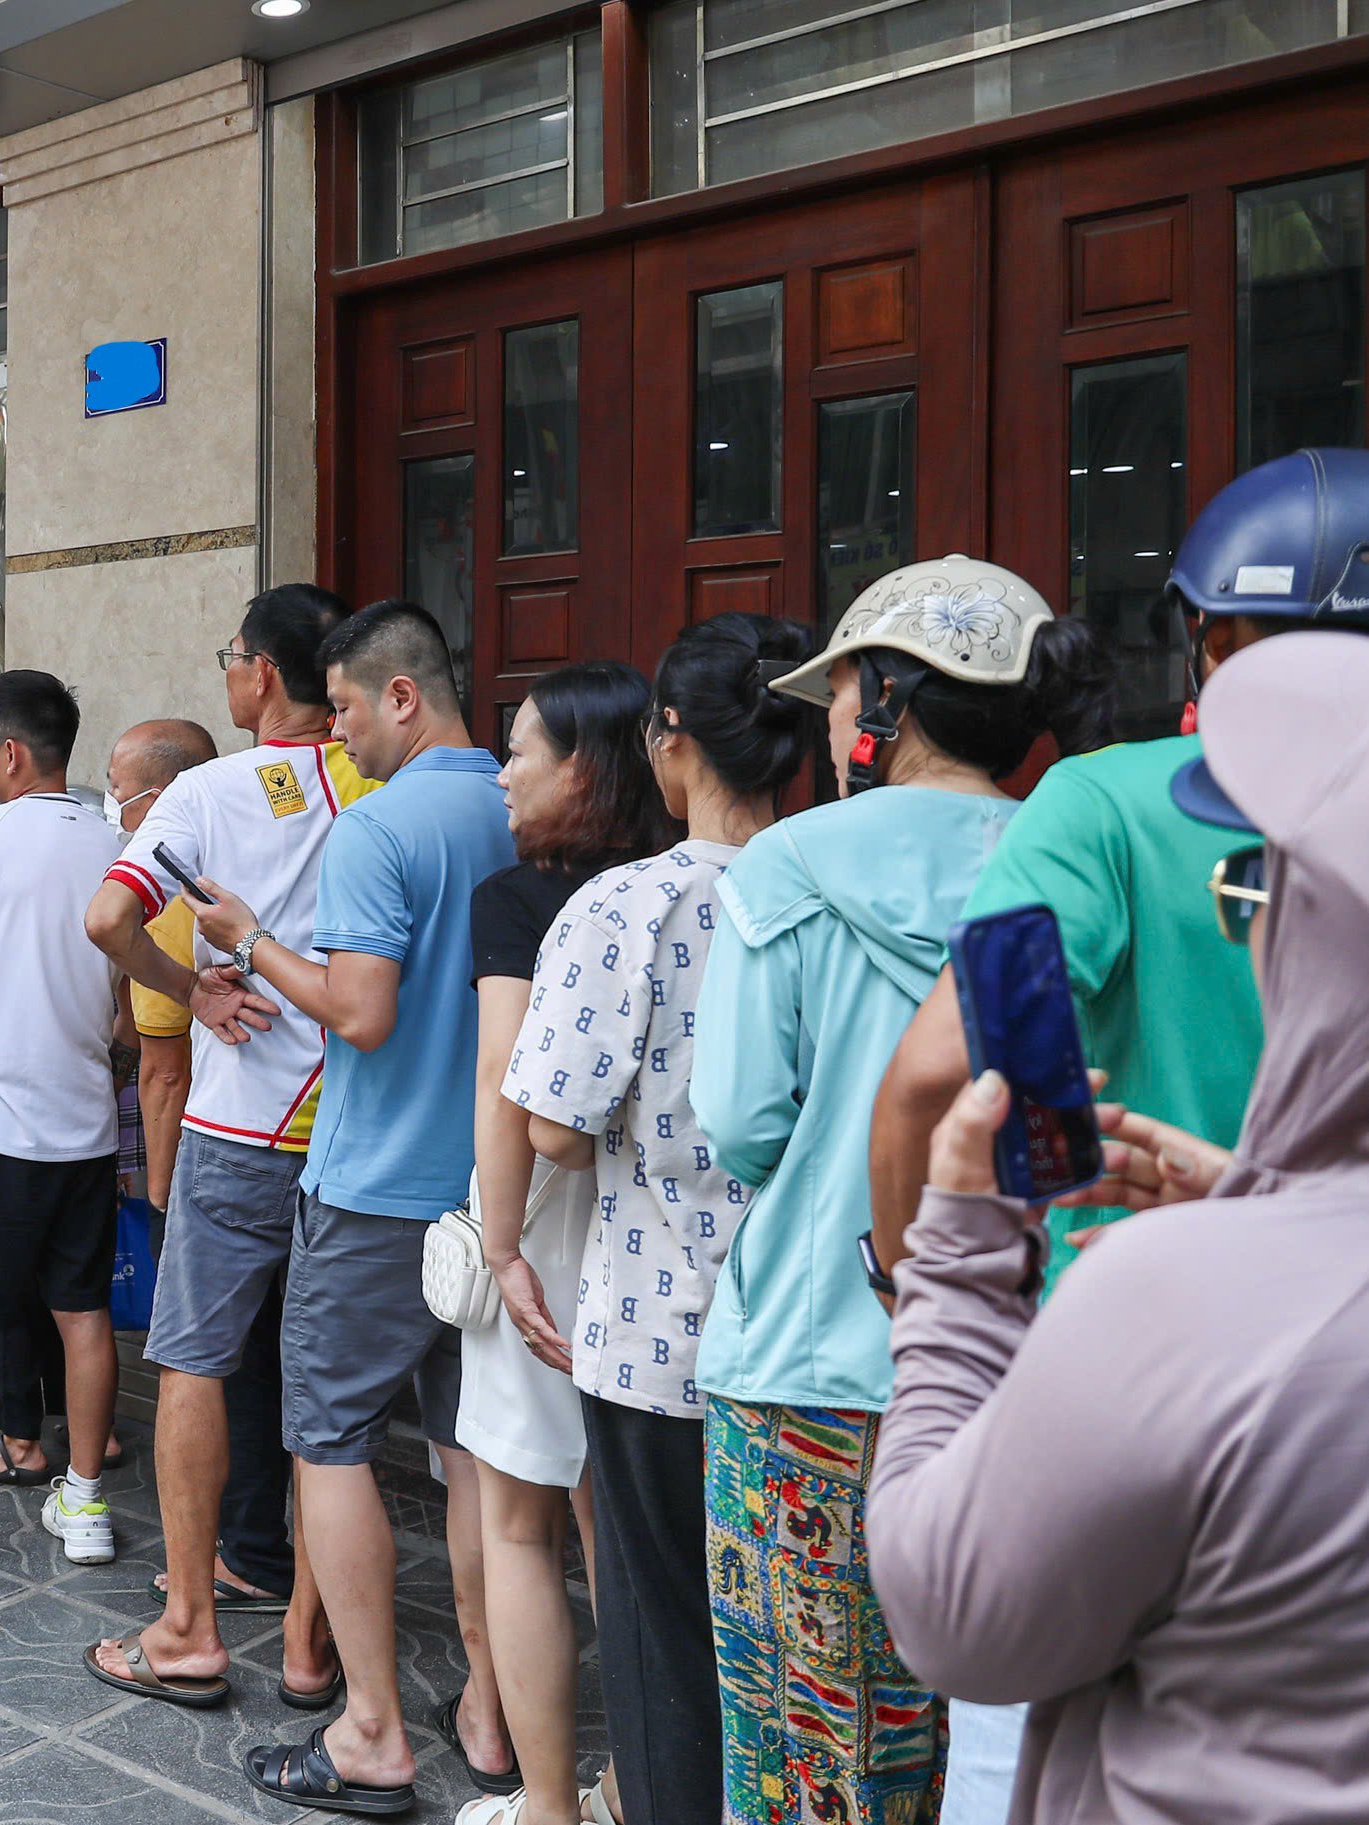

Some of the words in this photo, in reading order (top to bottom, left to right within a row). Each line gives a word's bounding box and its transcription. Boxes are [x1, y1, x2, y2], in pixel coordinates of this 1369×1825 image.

[270, 787, 300, 800] HANDLE
[272, 796, 288, 805] WITH
[288, 793, 302, 801] CARE
